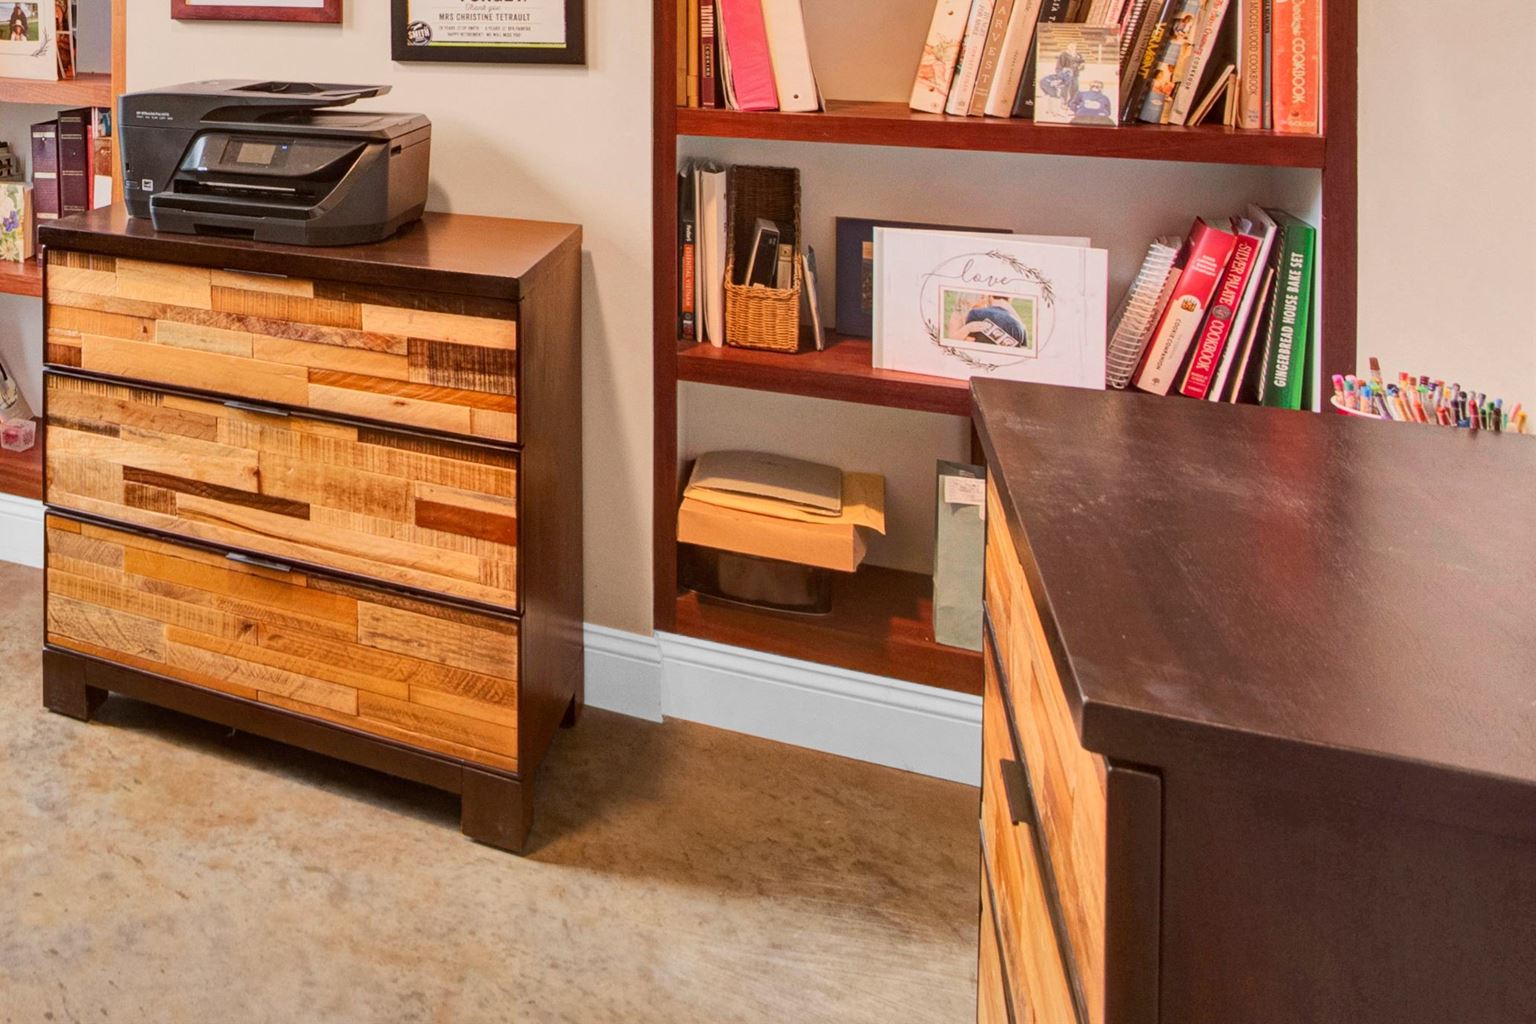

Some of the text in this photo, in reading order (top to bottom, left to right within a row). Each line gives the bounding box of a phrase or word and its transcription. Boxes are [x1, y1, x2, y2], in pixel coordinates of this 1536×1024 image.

[439, 12, 531, 21] MRS CHRISTINE TETRAULT
[1248, 2, 1257, 52] MOOSEWOOD
[1139, 22, 1167, 79] VERMONT
[1185, 57, 1200, 90] COOKBOOK
[1247, 54, 1257, 95] COOKBOOK
[1291, 37, 1304, 103] COOKBOOK
[959, 259, 1013, 286] love
[684, 279, 693, 306] VIETNAM
[1196, 242, 1252, 371] SILVER PALATE COOKBOOK
[1167, 317, 1182, 338] COOKIE
[1273, 251, 1304, 387] GINGERBREAD HOUSE BAKE SET
[1152, 337, 1174, 370] COMPANION
